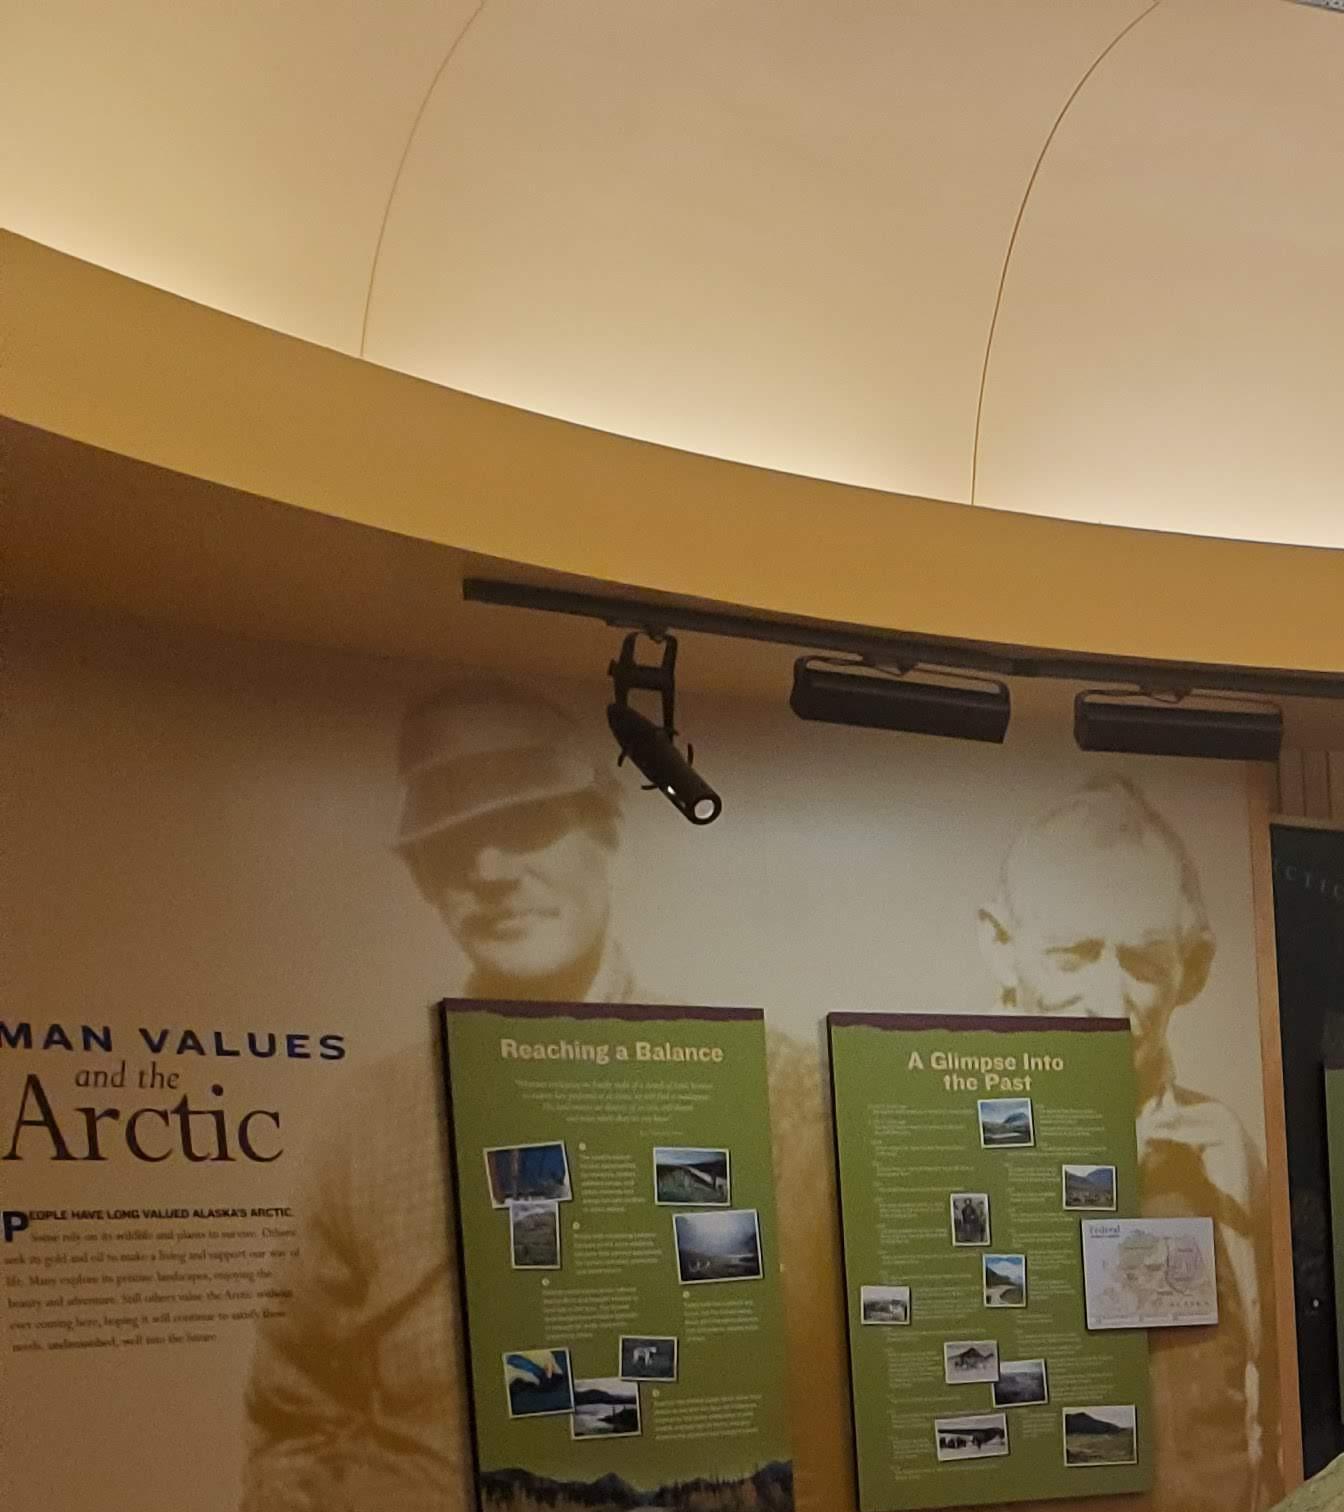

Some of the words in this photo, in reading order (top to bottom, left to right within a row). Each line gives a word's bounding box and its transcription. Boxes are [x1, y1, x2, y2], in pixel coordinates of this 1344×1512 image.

[1276, 866, 1344, 899] CTIC
[0, 1022, 112, 1053] MAN
[138, 1027, 346, 1060] VALUES
[500, 1038, 609, 1064] Reaching
[616, 1044, 629, 1060] a
[635, 1041, 724, 1063] Balance
[75, 1060, 126, 1088] and
[137, 1061, 180, 1089] the
[908, 1052, 924, 1070] A
[930, 1052, 1017, 1074] Glimpse
[1023, 1052, 1064, 1072] Into
[944, 1074, 978, 1091] the
[985, 1074, 1032, 1092] Past
[2, 1073, 284, 1162] Arctic
[72, 1209, 104, 1220] HAVE
[107, 1209, 139, 1220] LONG
[143, 1208, 189, 1219] VALUED
[193, 1208, 247, 1218] ALASKA'S
